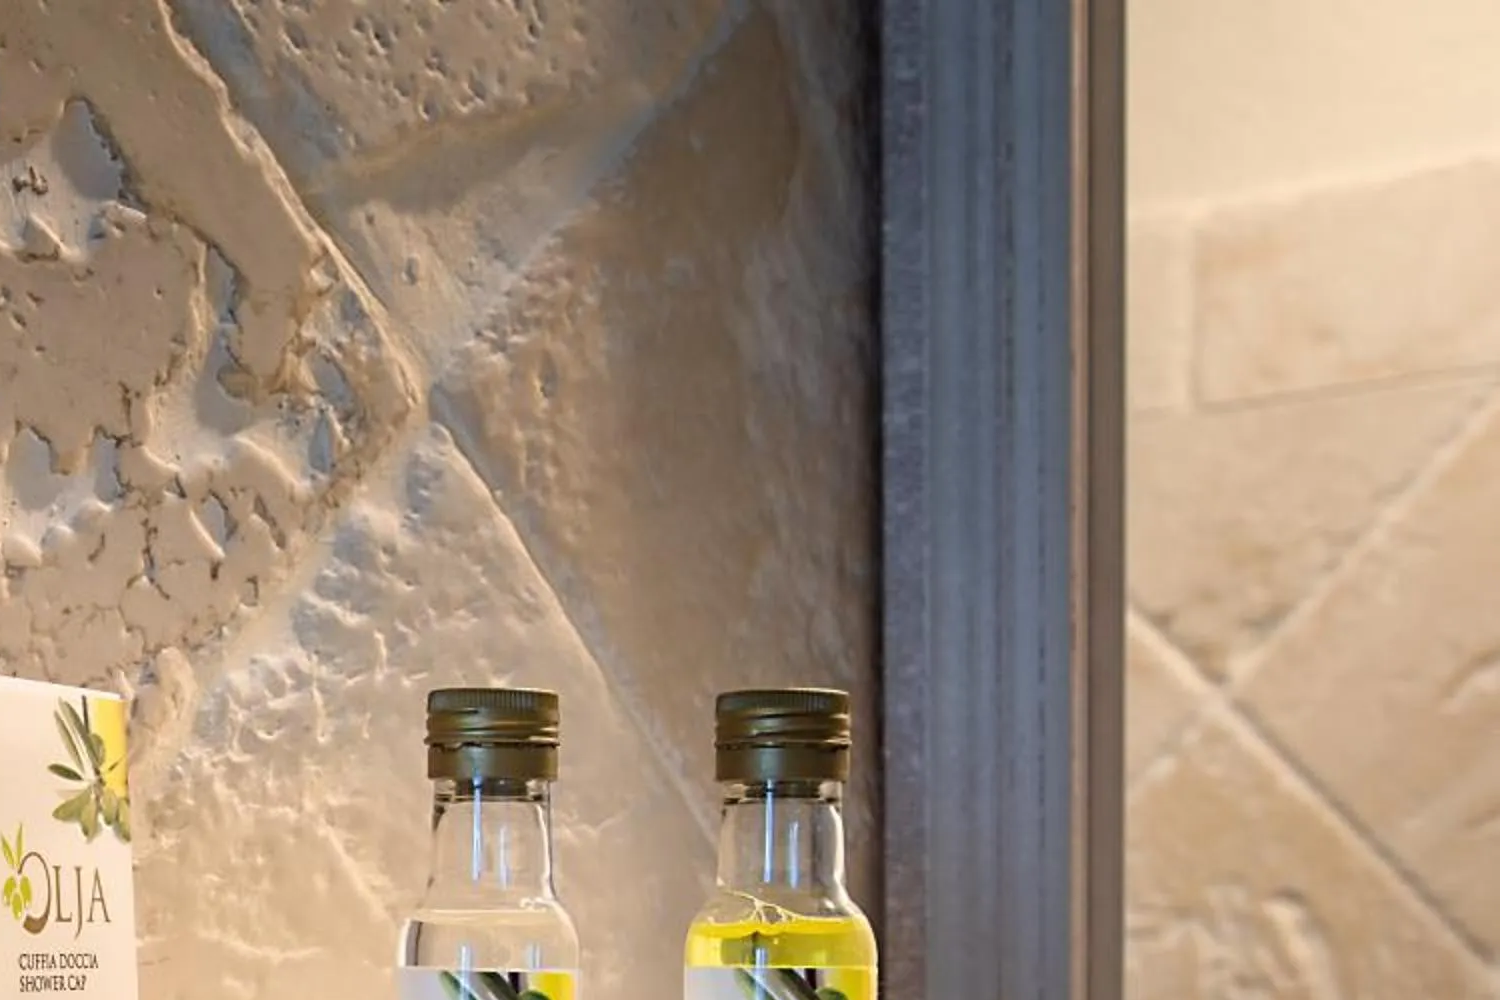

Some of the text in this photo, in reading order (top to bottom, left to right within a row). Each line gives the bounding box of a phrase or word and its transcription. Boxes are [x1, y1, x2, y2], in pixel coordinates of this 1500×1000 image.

[17, 851, 111, 940] OLJA
[18, 953, 99, 970] CUFFIA DOCCIA
[19, 974, 87, 992] SHOWER CAP
